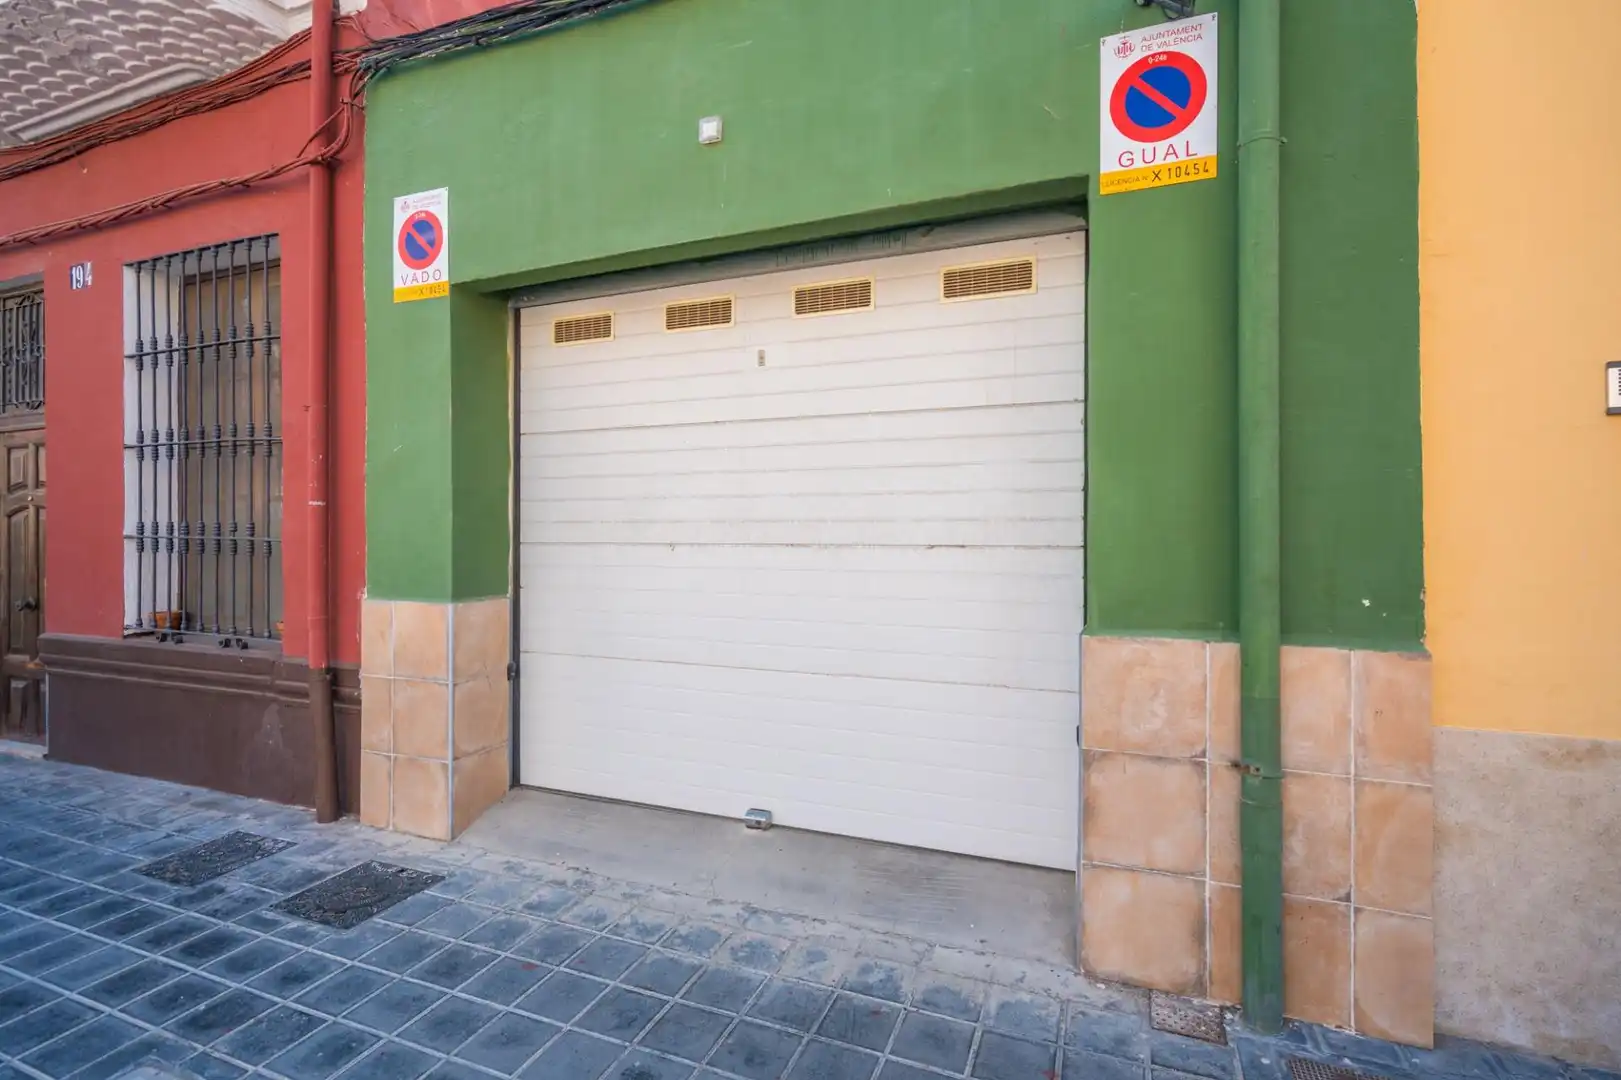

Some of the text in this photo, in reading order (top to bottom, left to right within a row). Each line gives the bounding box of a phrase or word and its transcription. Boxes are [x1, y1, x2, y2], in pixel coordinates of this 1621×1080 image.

[1140, 23, 1204, 43] AJUNTAMENT
[1141, 42, 1154, 53] DE
[1118, 140, 1197, 168] GUAL
[1152, 168, 1162, 183] X
[1167, 160, 1210, 180] 10454
[71, 262, 92, 290] 194
[401, 269, 442, 286] VADO
